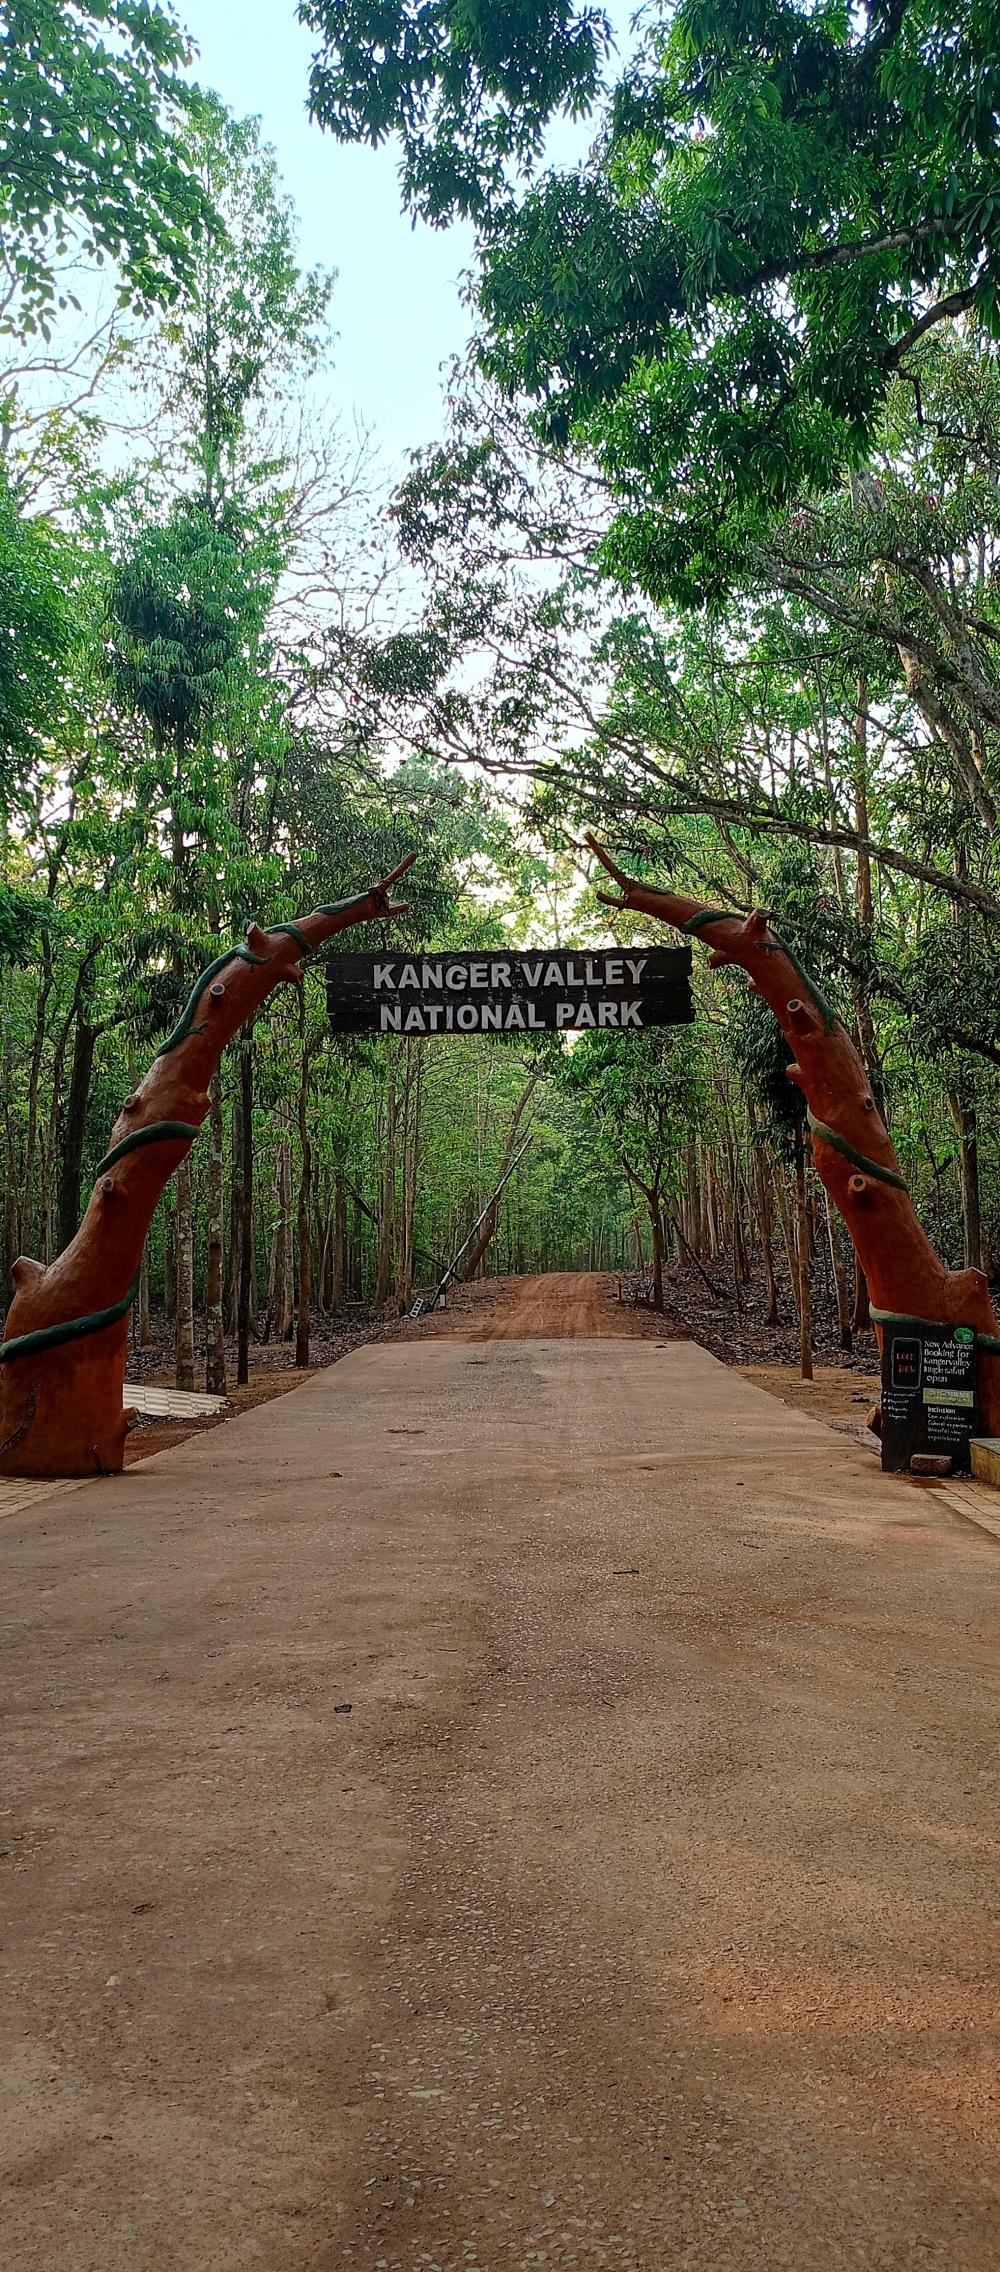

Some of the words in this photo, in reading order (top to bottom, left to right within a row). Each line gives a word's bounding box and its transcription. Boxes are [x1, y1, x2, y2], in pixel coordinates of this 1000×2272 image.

[373, 963, 511, 991] KANGER
[522, 959, 648, 988] VALLEY
[380, 1003, 546, 1030] NATIONAL
[556, 1001, 644, 1027] PARK
[942, 1340, 974, 1350] Advance
[924, 1348, 955, 1358] Booking
[957, 1350, 970, 1358] for
[926, 1376, 948, 1384] open
